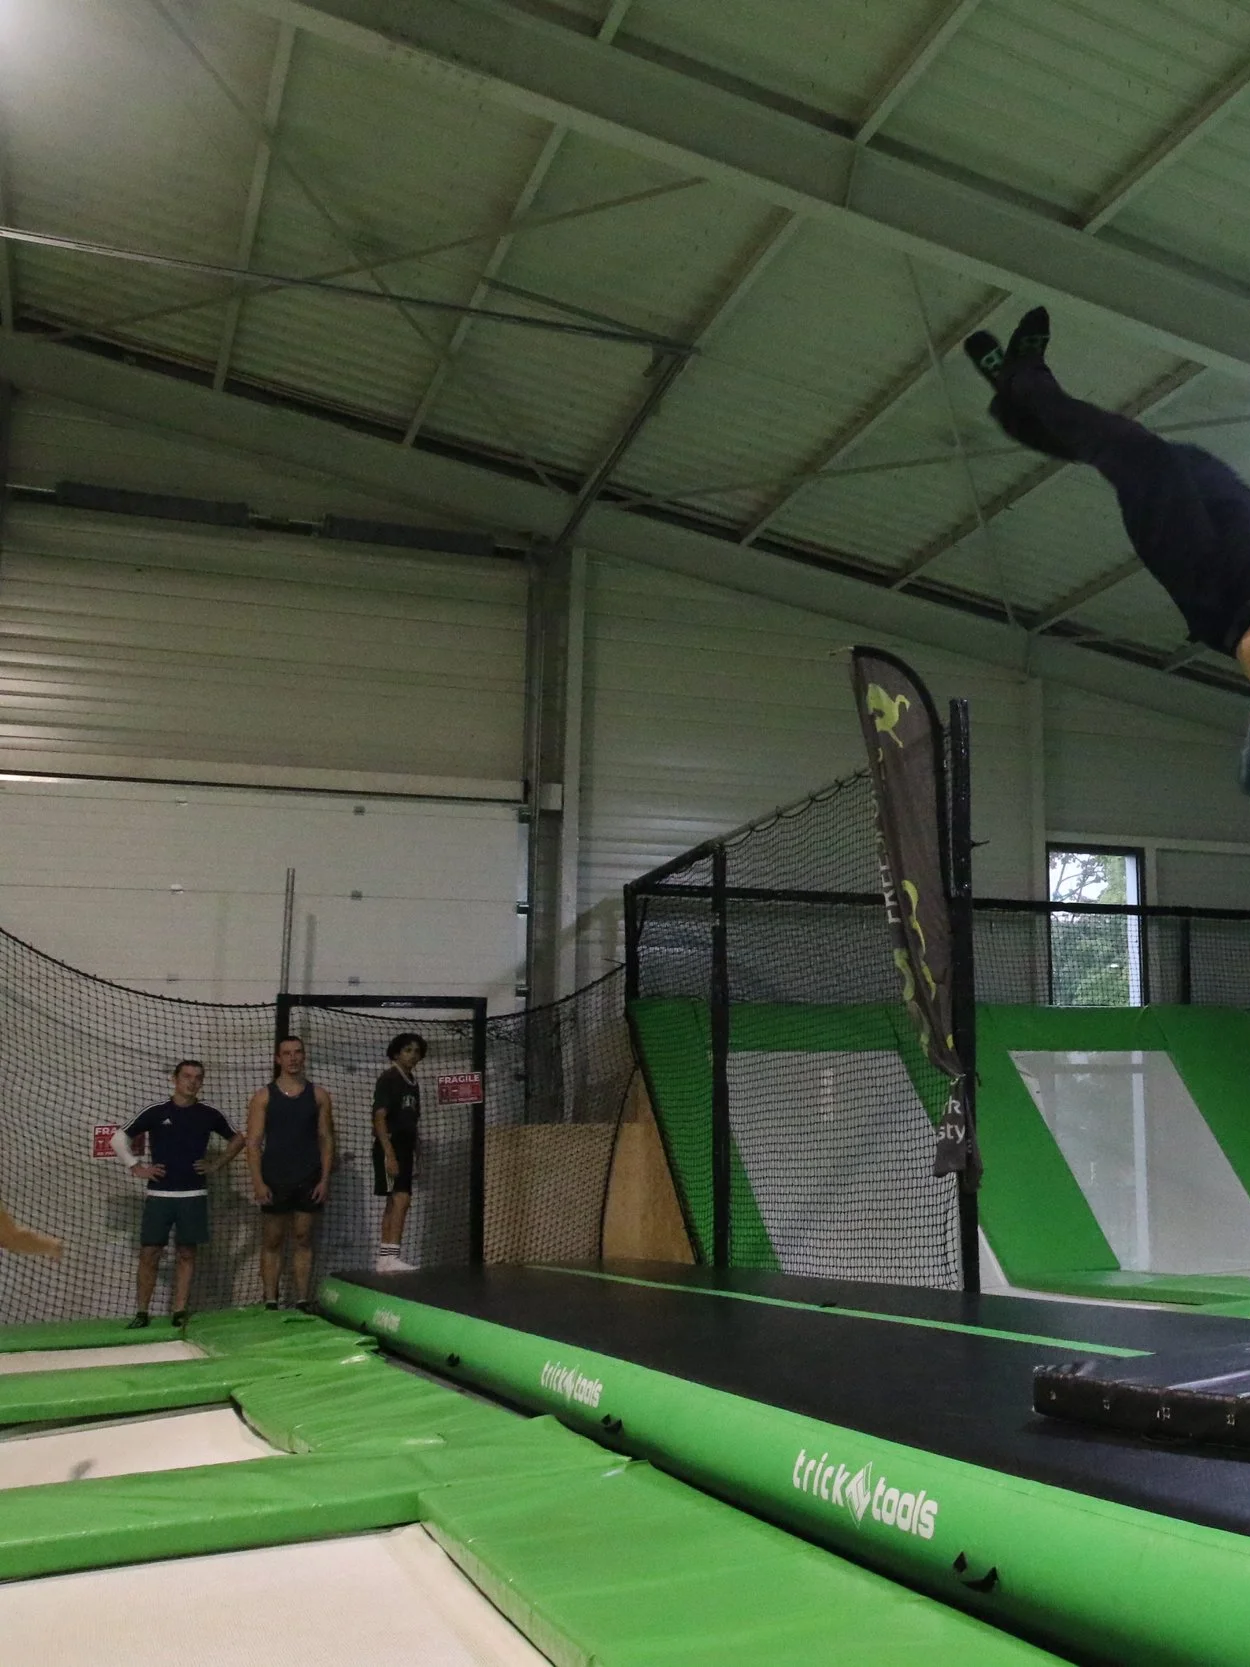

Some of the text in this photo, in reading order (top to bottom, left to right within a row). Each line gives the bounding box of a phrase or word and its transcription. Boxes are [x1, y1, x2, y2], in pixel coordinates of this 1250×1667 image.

[438, 1074, 480, 1085] FRAGILE
[541, 1360, 603, 1409] trick tools
[793, 1449, 938, 1540] trick tools
